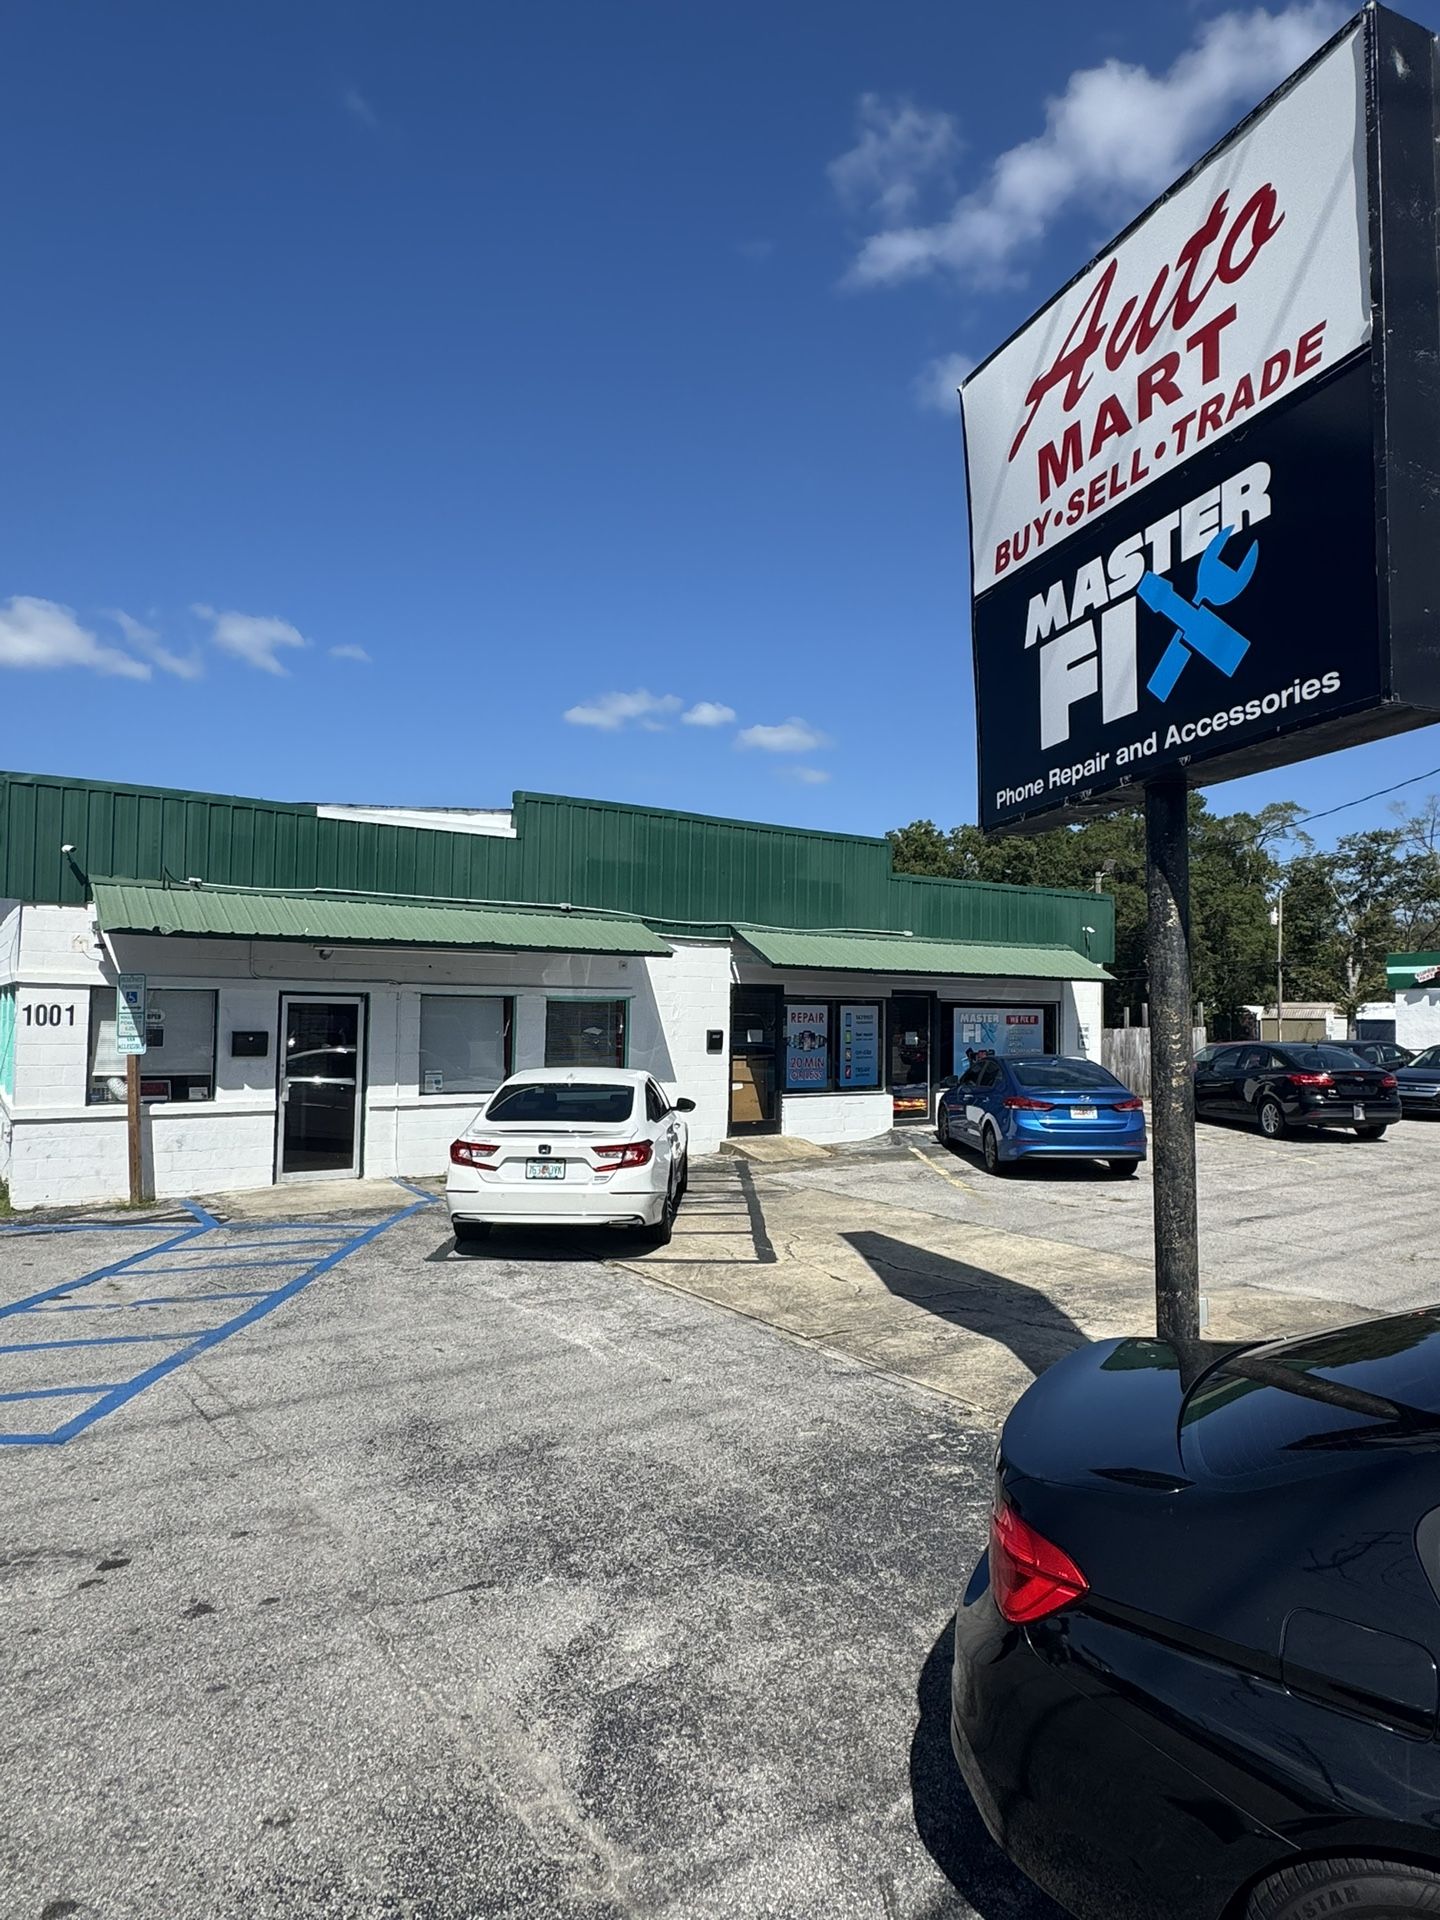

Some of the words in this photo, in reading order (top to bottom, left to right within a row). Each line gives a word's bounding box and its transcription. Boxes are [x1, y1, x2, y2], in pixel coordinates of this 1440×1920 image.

[1008, 182, 1286, 462] Auto
[994, 515, 1051, 575] BUY
[1066, 450, 1150, 525] SELL
[1171, 320, 1327, 456] TRADE
[1038, 304, 1237, 503] MART
[1024, 461, 1272, 649] MASTER
[996, 766, 1044, 810] Phone
[1048, 751, 1110, 790] Repair
[1115, 731, 1157, 768] and
[1164, 670, 1341, 749] Accessories
[22, 1004, 76, 1027] 1001
[790, 1012, 825, 1024] REPAIR
[803, 1056, 825, 1069] MIN
[960, 1013, 1000, 1024] MASTER
